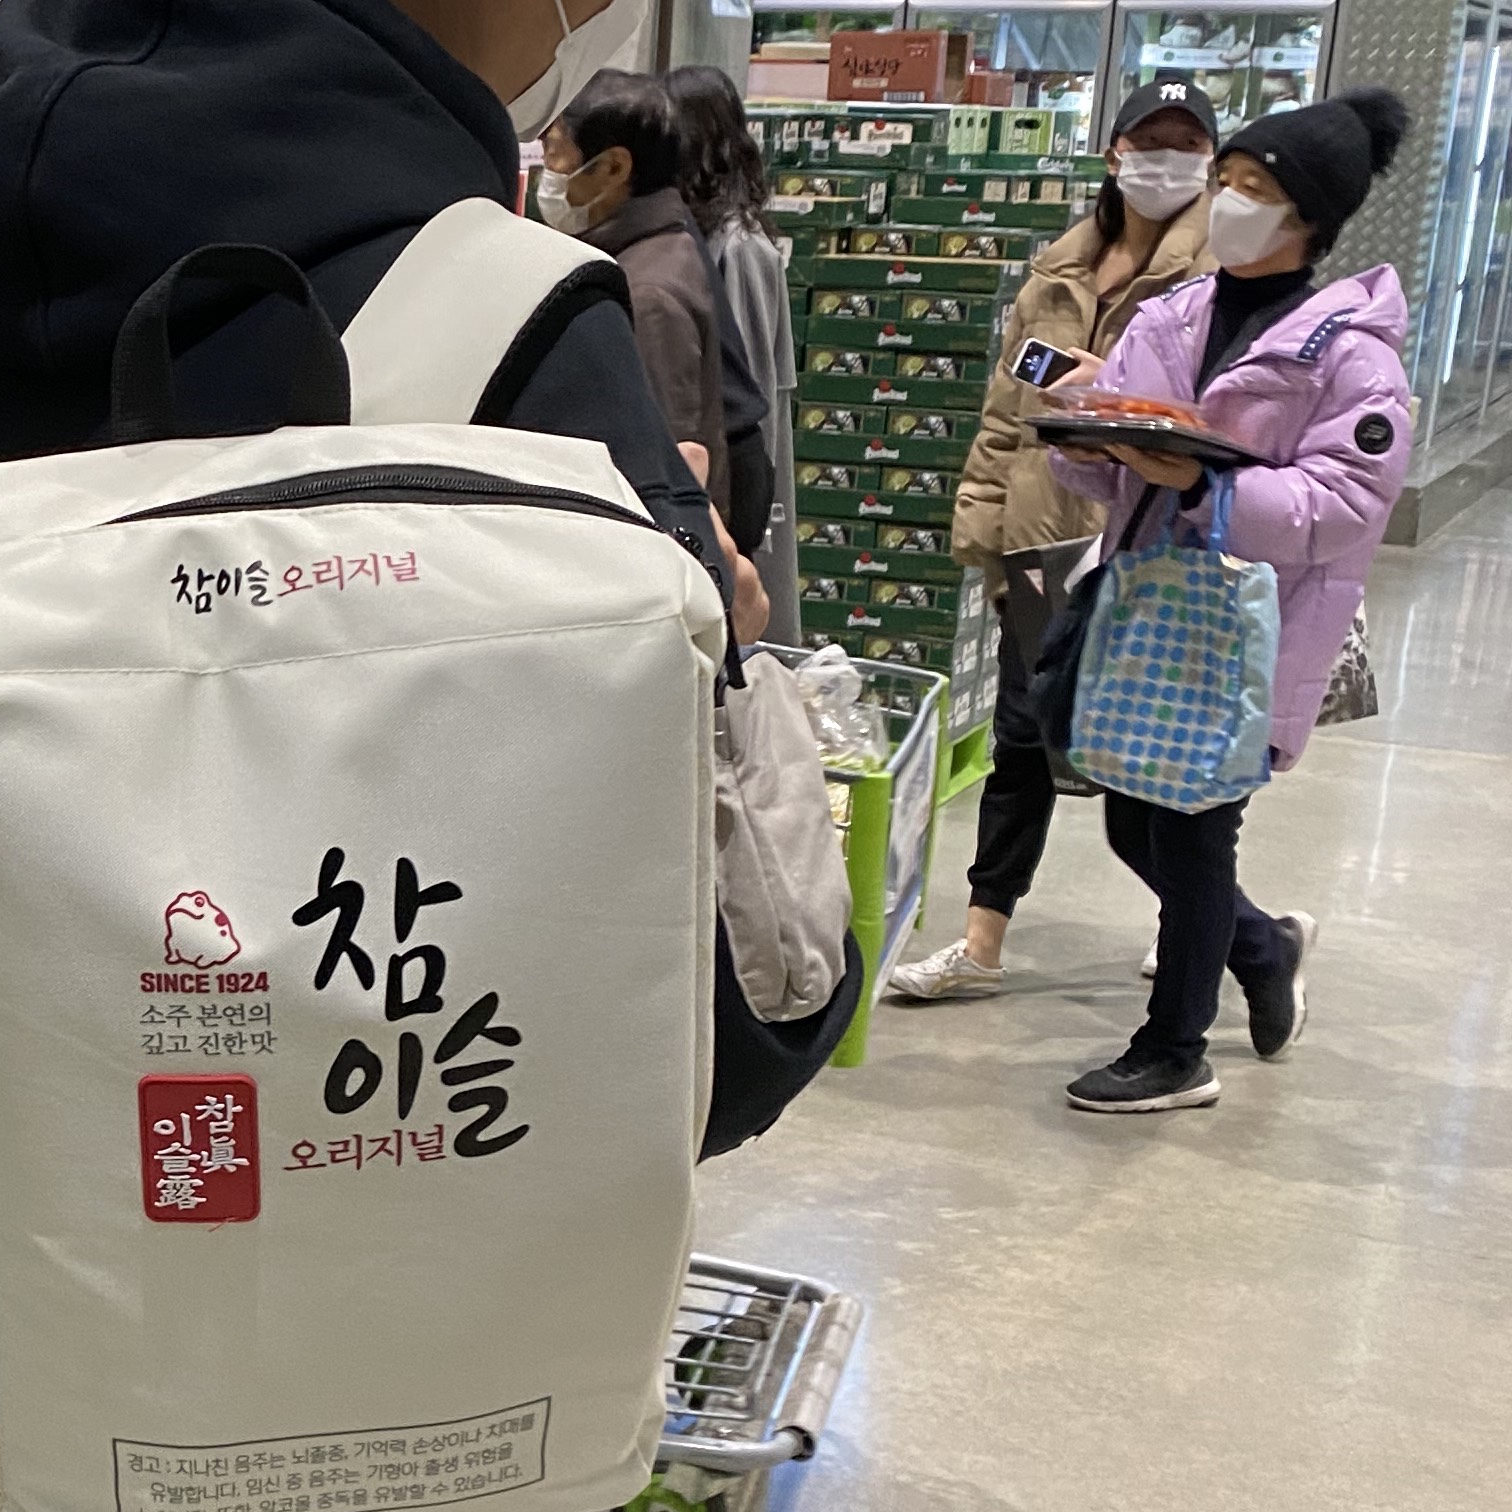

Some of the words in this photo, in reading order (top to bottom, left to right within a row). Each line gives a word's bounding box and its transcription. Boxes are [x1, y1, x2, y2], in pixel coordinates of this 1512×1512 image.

[291, 847, 463, 1022] 참
[140, 972, 210, 993] SINCE
[216, 972, 270, 993] 1924
[140, 1004, 192, 1028] 소주
[196, 1002, 270, 1027] 본연의
[141, 1032, 192, 1055] 깊고
[324, 992, 530, 1158] 이슬
[283, 1124, 447, 1172] 오리지널
[127, 1453, 161, 1473] 경고
[176, 1457, 228, 1479] 지나친
[236, 1452, 286, 1473] 음주는
[354, 1440, 406, 1458] 기억력
[413, 1428, 481, 1455] 손상이나
[247, 1476, 280, 1496] 임신
[286, 1473, 303, 1490] 중
[309, 1468, 360, 1488] 음주는
[368, 1462, 418, 1480] 기형아
[425, 1456, 459, 1476] 출생
[318, 1488, 368, 1509] 중독을
[375, 1484, 427, 1503] 유발할
[432, 1482, 449, 1495] 수
